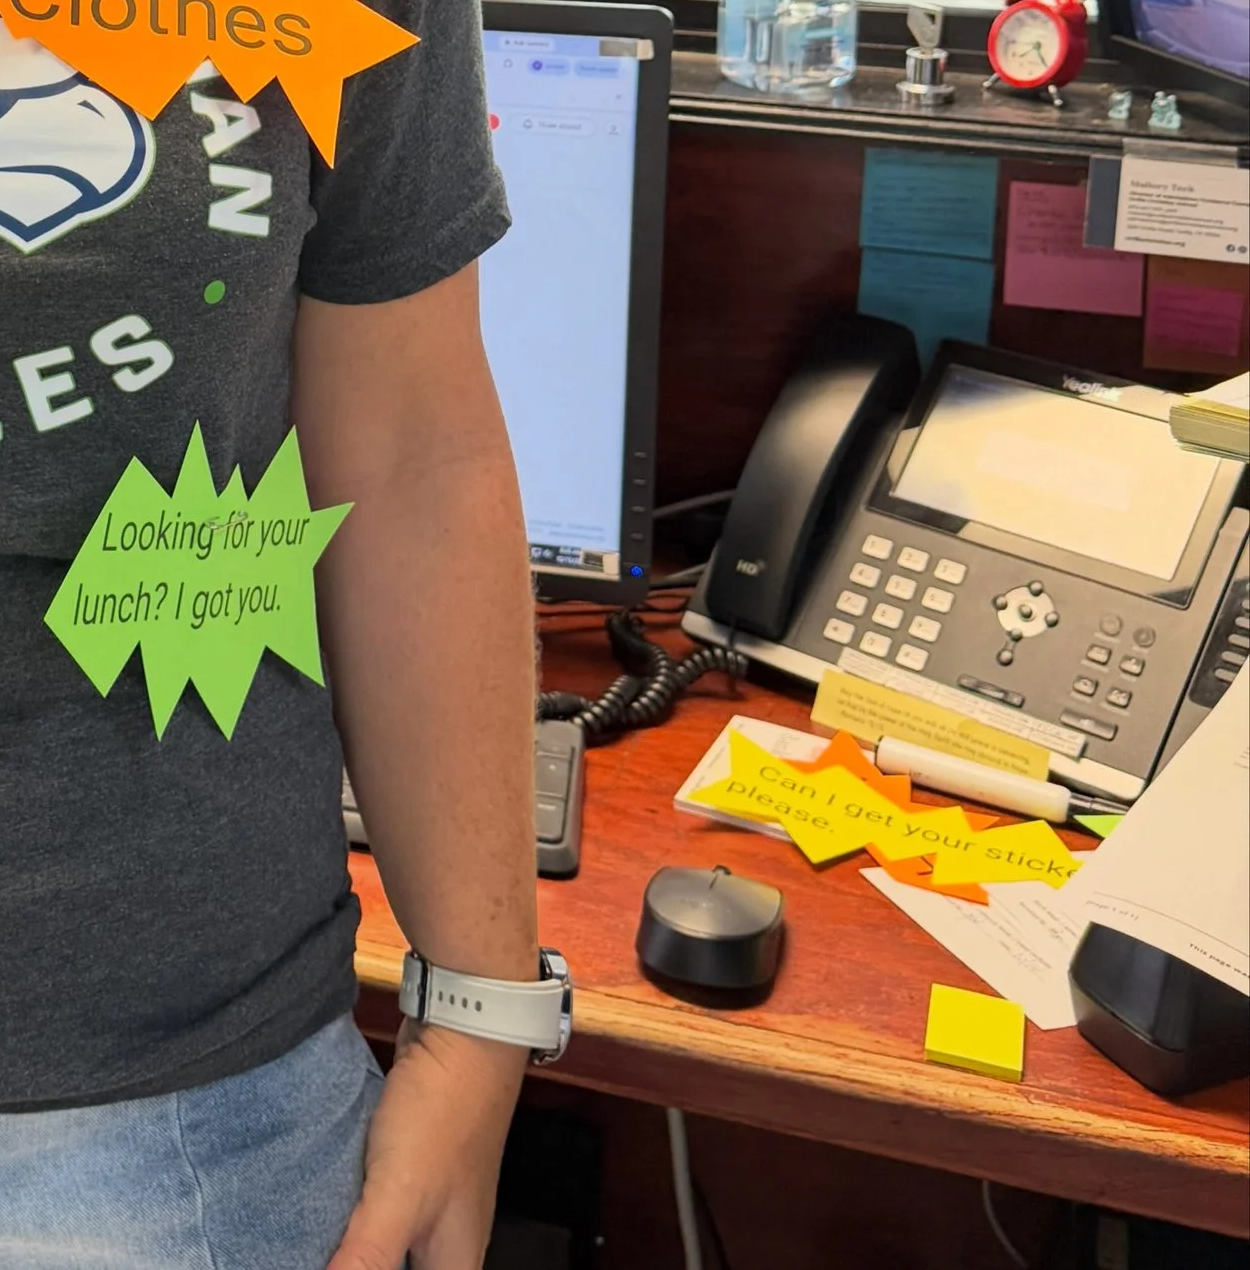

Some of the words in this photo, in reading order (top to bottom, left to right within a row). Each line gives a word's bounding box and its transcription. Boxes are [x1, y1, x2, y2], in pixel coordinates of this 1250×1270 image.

[102, 509, 215, 561] Looking
[223, 509, 255, 551] for
[255, 517, 310, 558] your
[73, 581, 169, 626] lunch?
[174, 581, 185, 620] I
[190, 582, 233, 630] got
[234, 583, 281, 626] you.
[725, 779, 835, 834] please.
[758, 765, 818, 801] Can
[825, 793, 837, 807] I
[843, 802, 895, 829] get
[902, 822, 979, 853] your
